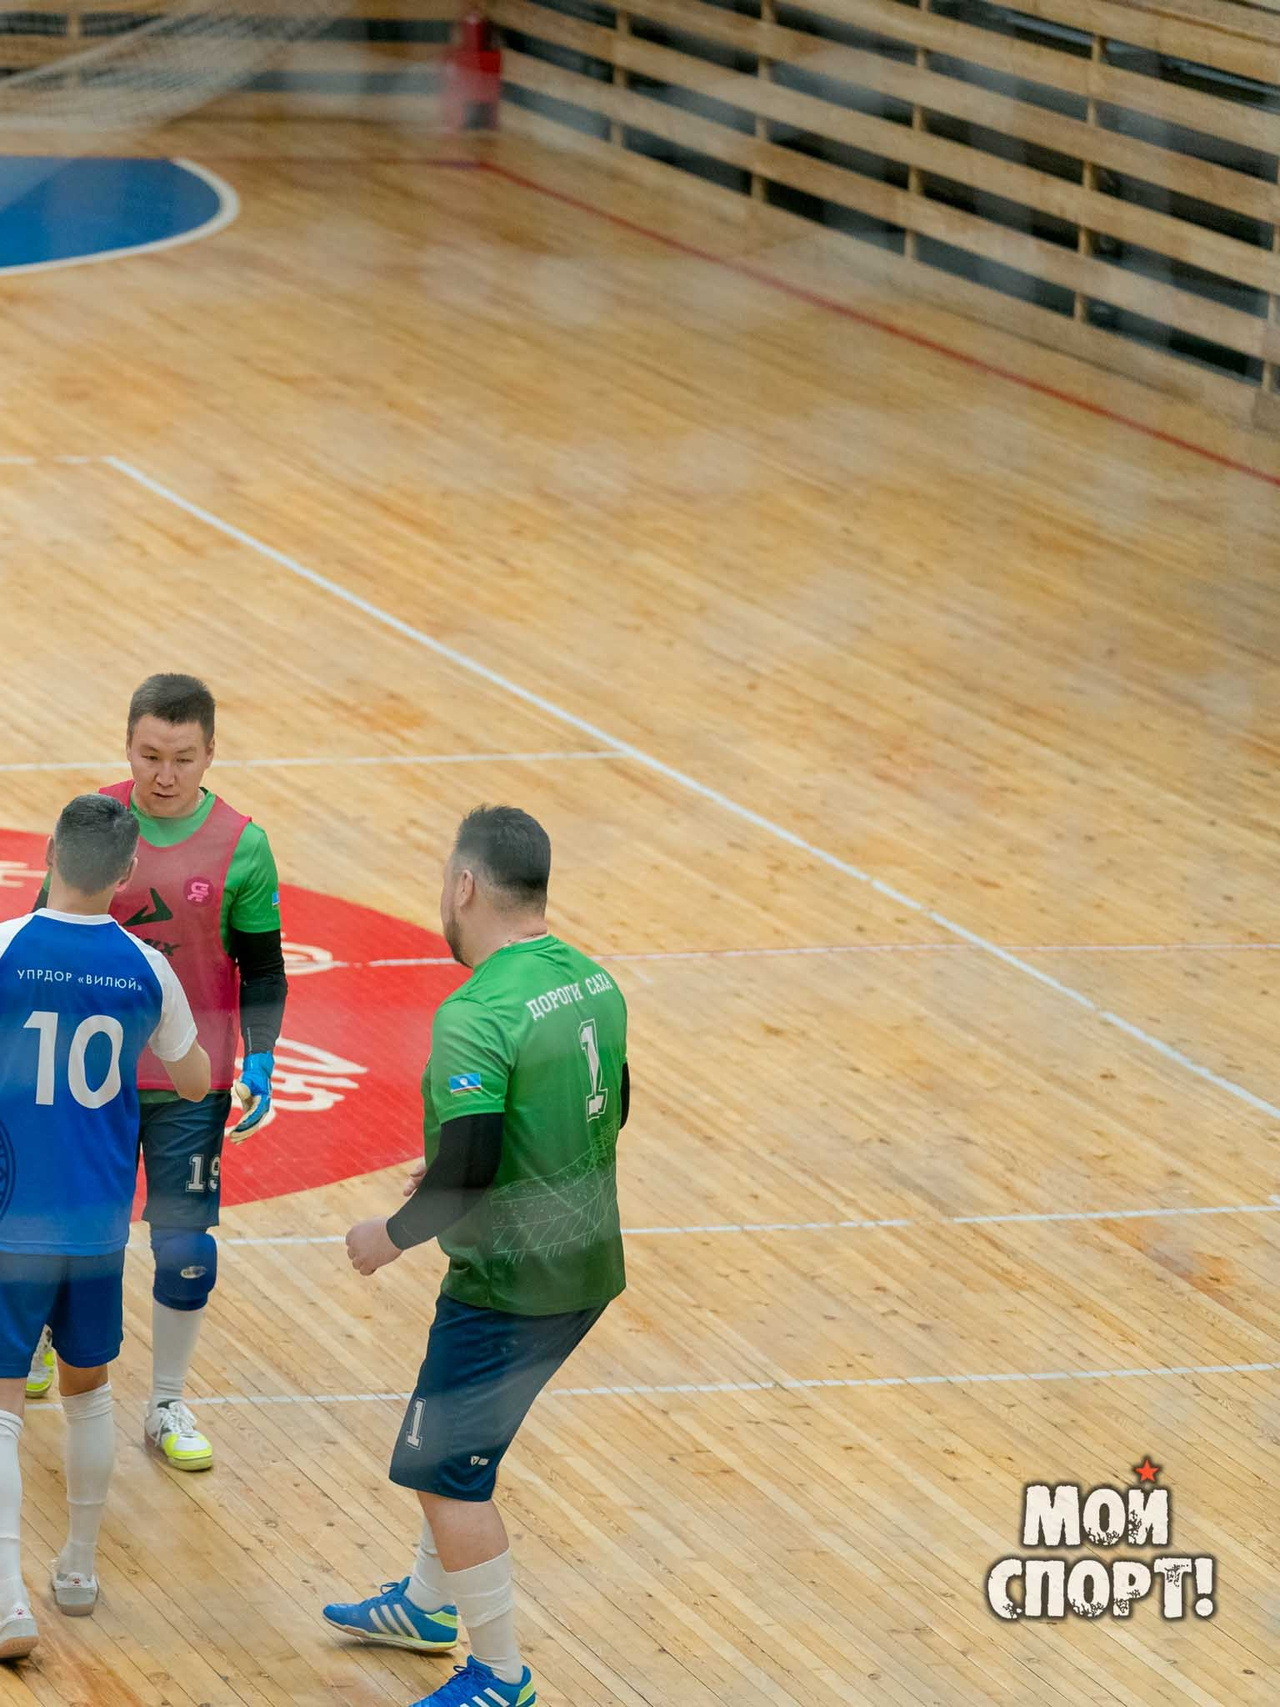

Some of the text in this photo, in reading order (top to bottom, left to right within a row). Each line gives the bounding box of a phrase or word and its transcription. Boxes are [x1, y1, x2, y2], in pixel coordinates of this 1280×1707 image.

[16, 969, 143, 992] УПРДОР «ВИЛЮЙ»
[525, 972, 613, 1021] ДОРОГИ САХА
[23, 1010, 124, 1110] 10
[578, 1018, 608, 1123] 1
[405, 1397, 427, 1450] 1
